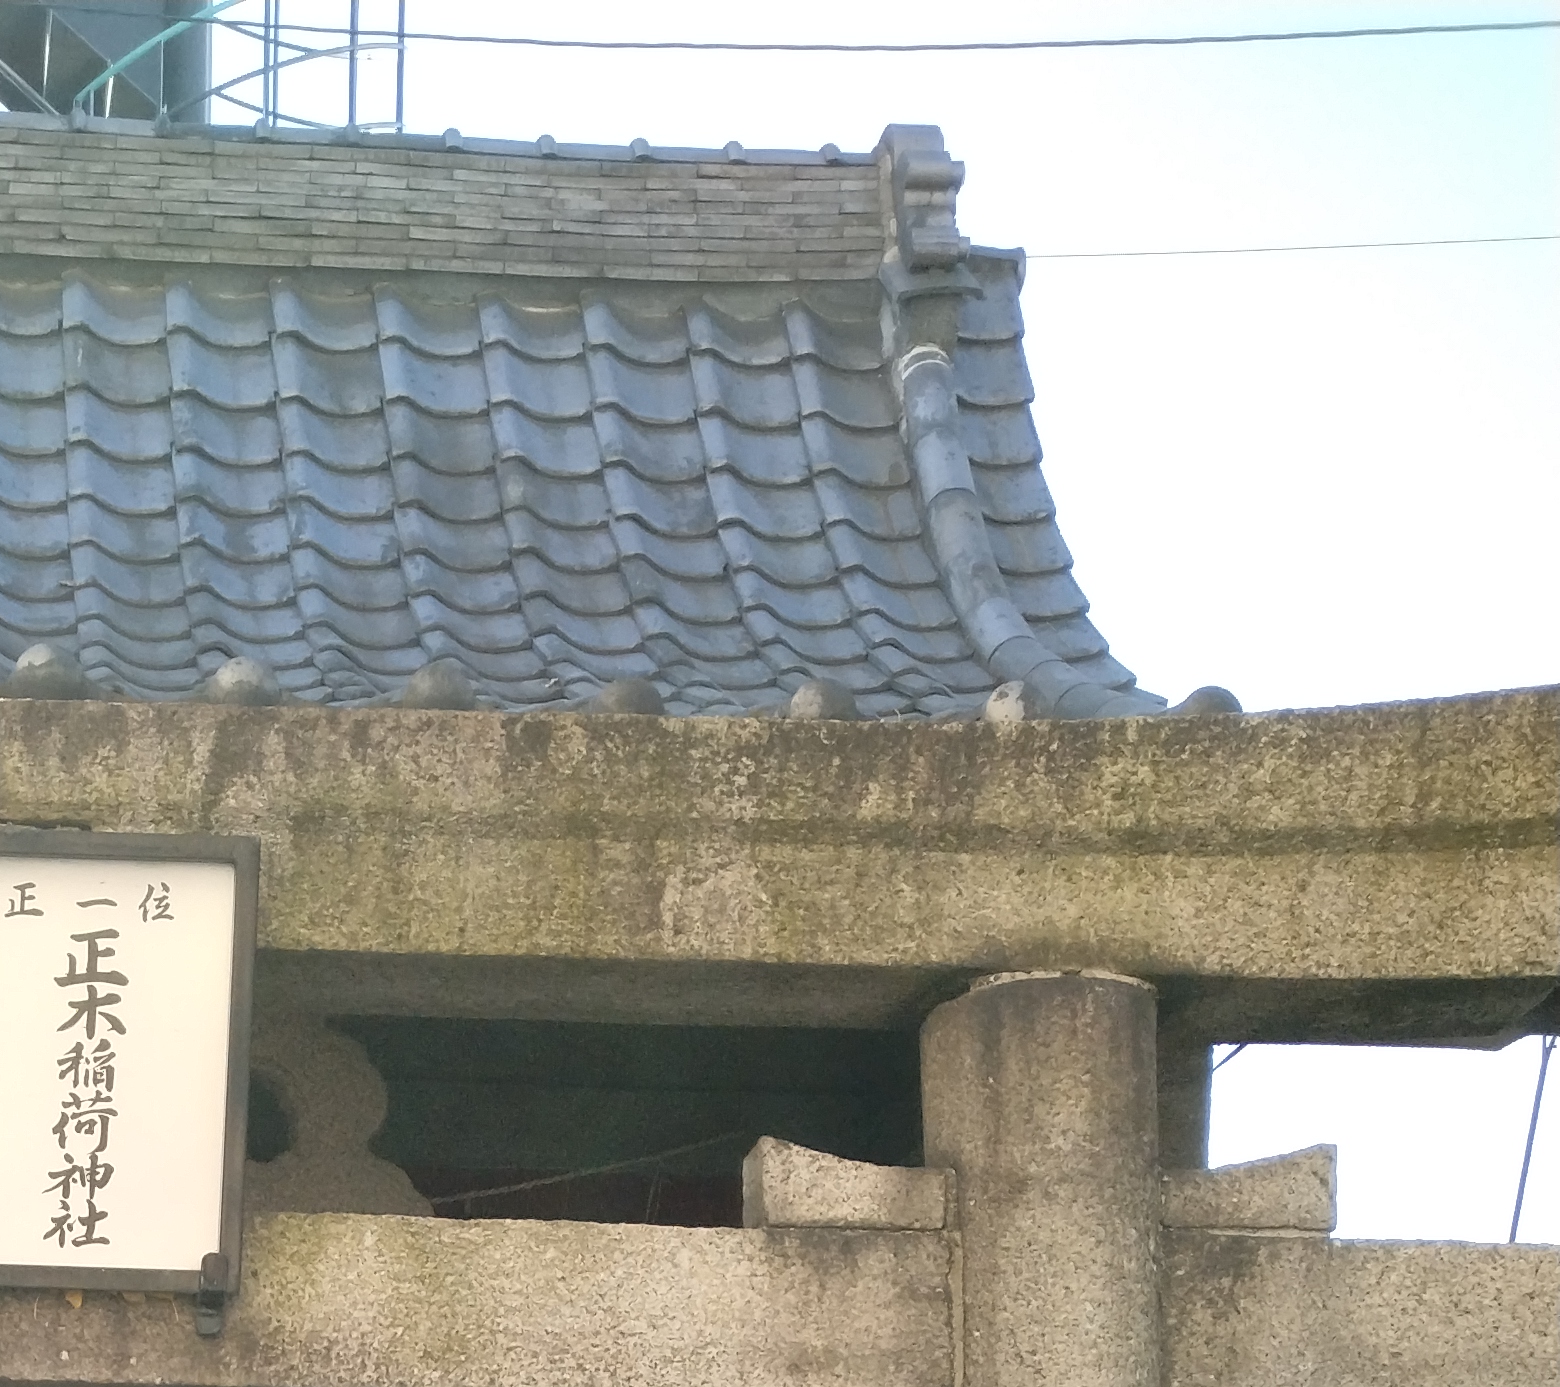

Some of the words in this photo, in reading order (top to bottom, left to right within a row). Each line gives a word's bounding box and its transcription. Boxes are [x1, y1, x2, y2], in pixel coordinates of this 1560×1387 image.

[4, 881, 175, 923] 正一位
[41, 928, 130, 1249] 正木稲荷神社
